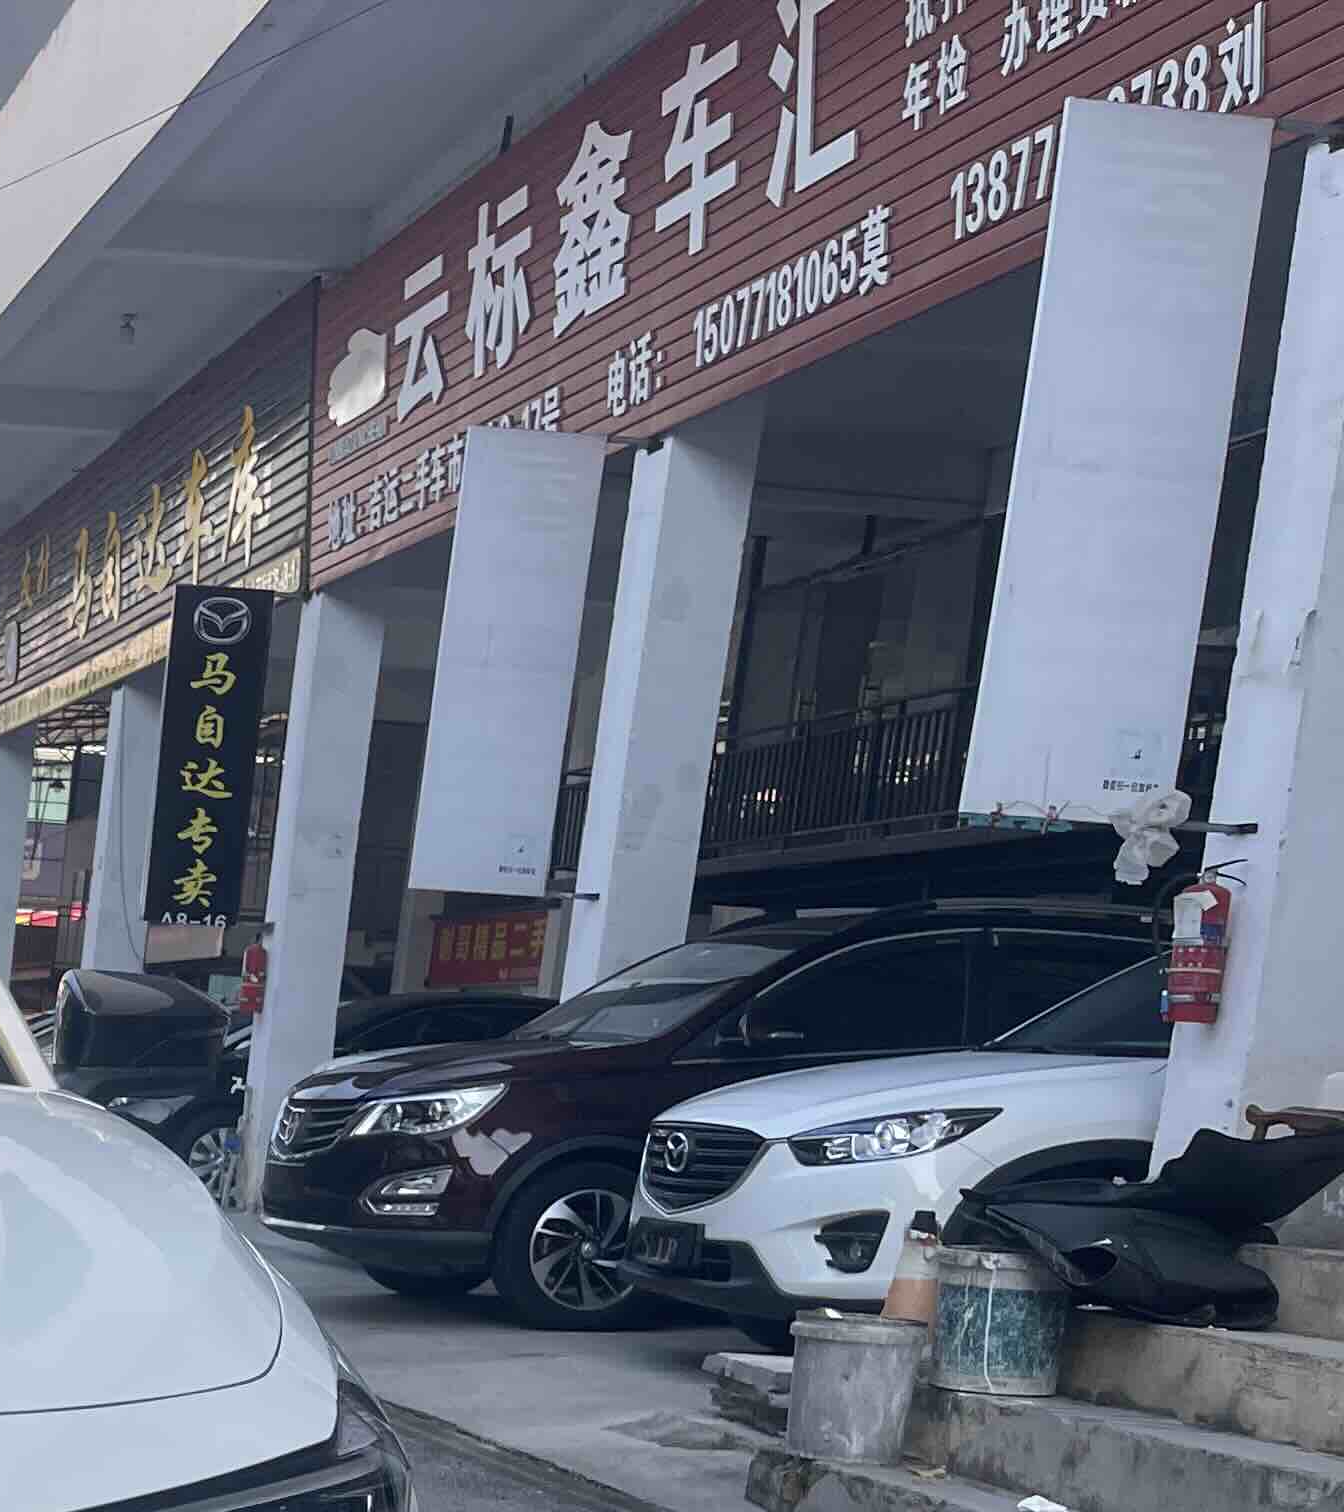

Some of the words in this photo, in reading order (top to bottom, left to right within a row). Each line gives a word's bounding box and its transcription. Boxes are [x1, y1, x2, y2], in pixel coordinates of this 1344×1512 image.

[392, 0, 858, 422] 云标鑫车汇
[693, 204, 894, 368] 15077181065莫
[1107, 1, 1265, 113] 738刘
[901, 34, 968, 131] 年检
[171, 652, 238, 908] 马自达专卖
